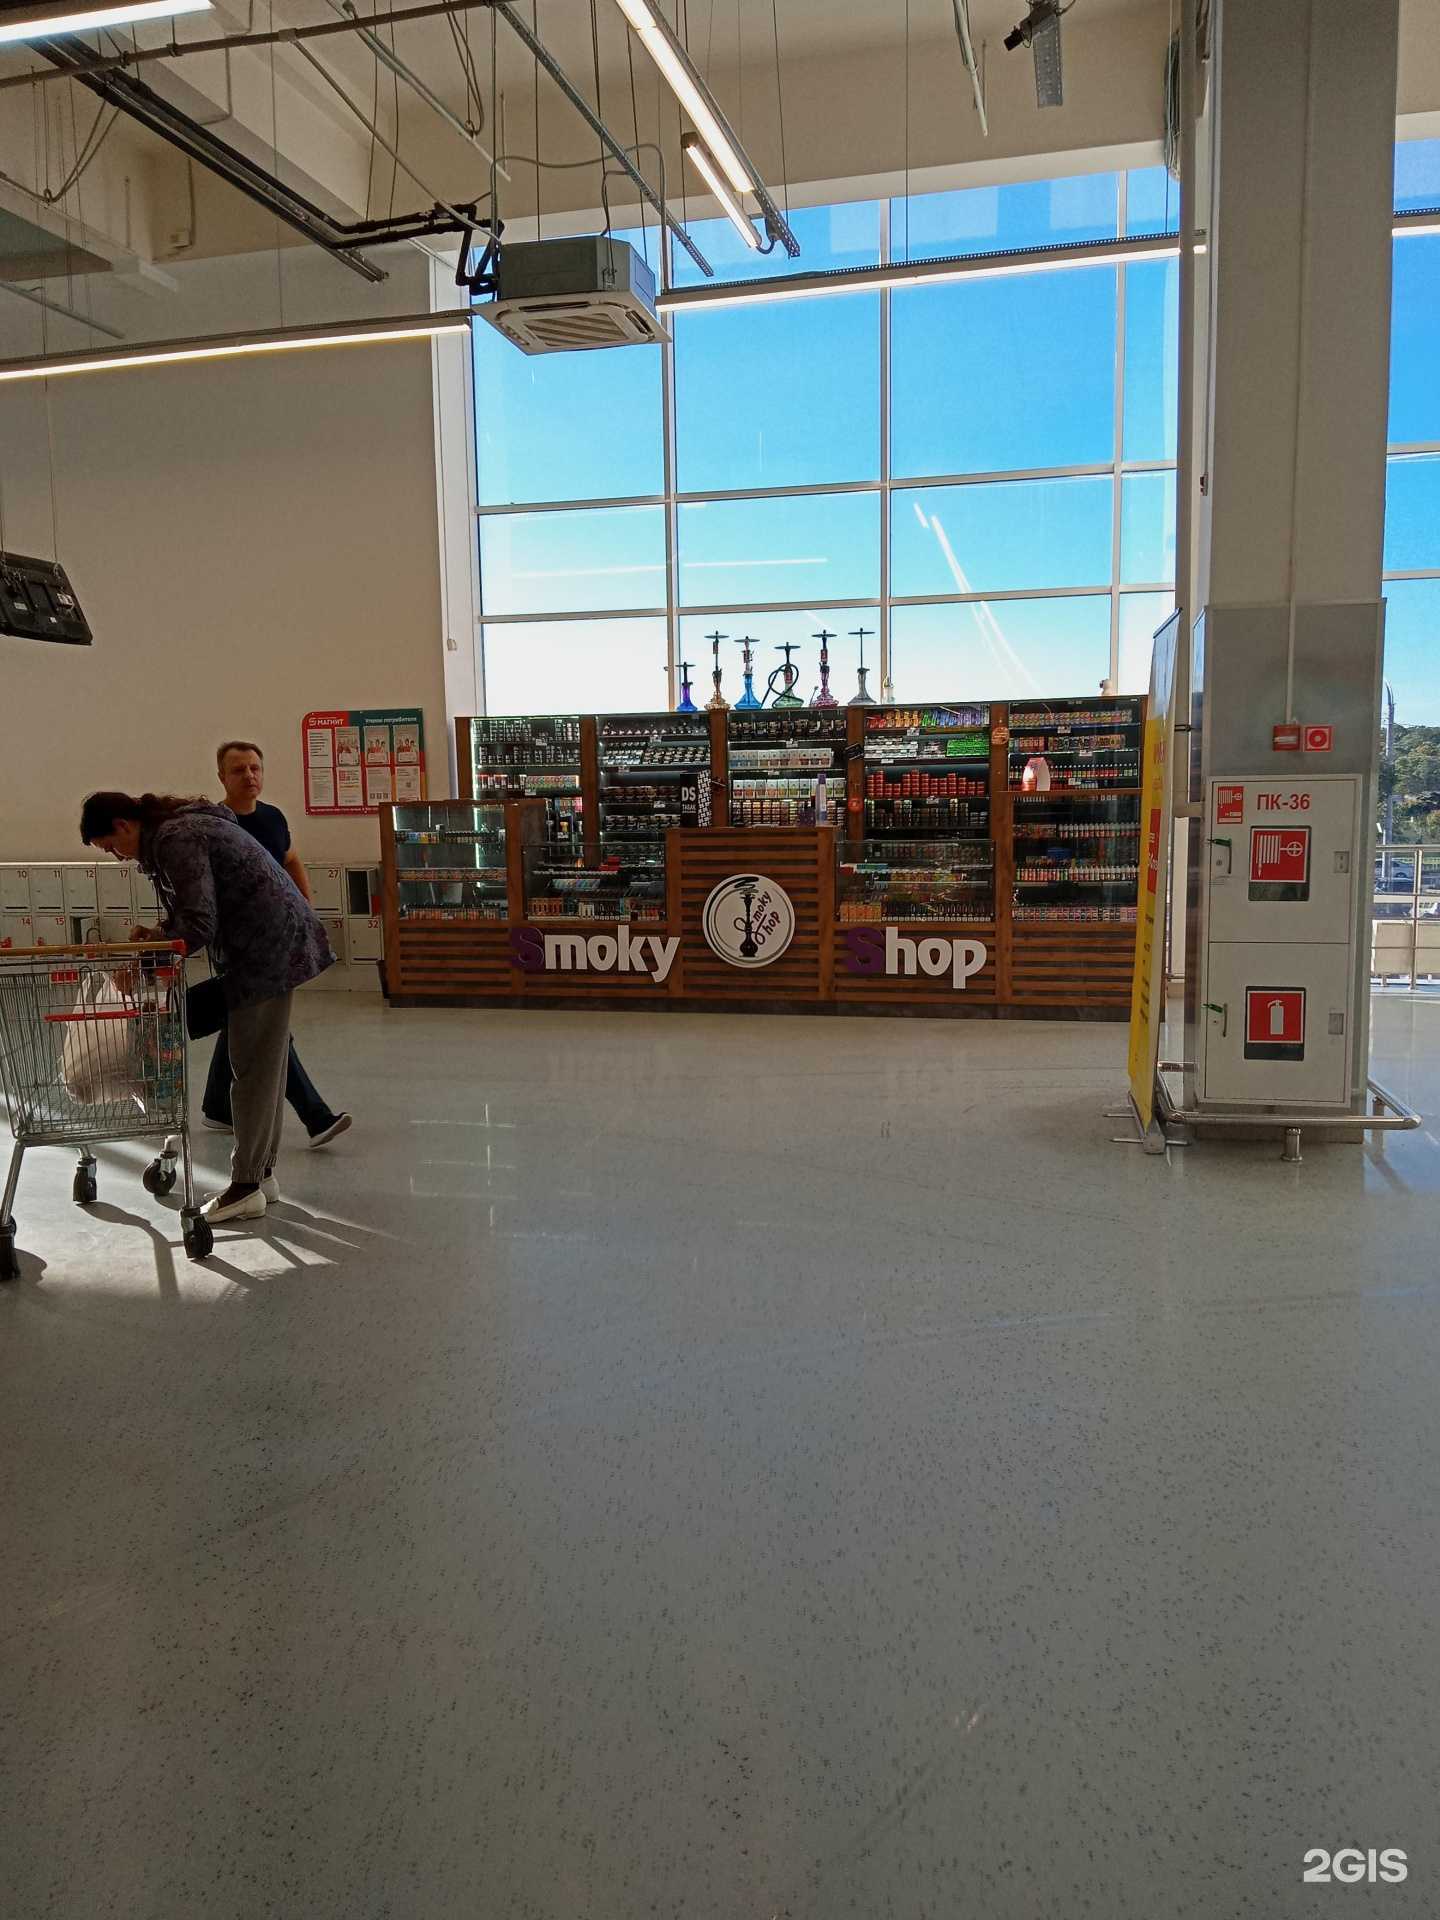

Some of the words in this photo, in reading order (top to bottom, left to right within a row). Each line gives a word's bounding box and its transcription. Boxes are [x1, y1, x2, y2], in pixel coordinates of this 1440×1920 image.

[681, 786, 696, 801] DS
[1257, 793, 1310, 810] ПК-36
[18, 870, 27, 878] 10
[53, 870, 61, 878] 11
[86, 870, 94, 878] 12
[120, 870, 128, 878] 17
[328, 870, 338, 878] 27
[22, 917, 31, 925] 14
[56, 917, 64, 925] 15
[512, 925, 680, 983] Smoky
[847, 926, 987, 989] Shop
